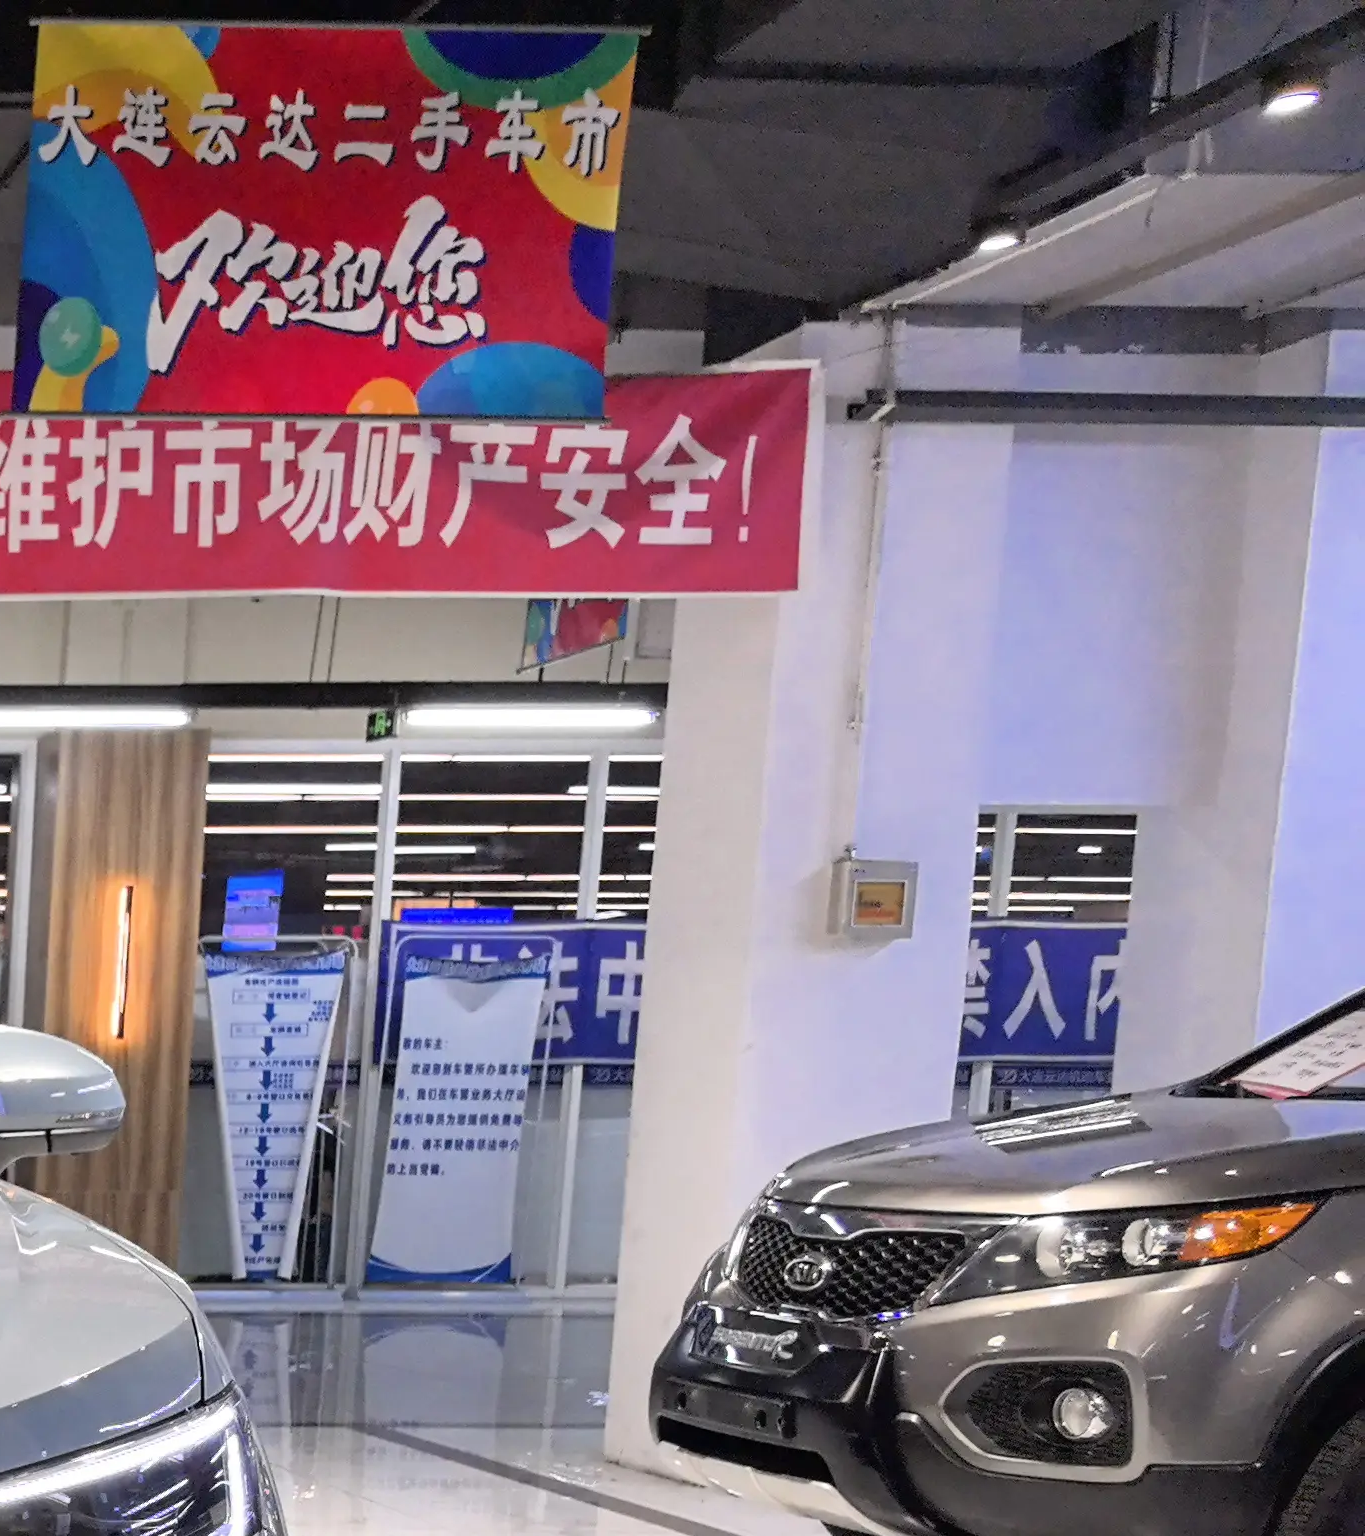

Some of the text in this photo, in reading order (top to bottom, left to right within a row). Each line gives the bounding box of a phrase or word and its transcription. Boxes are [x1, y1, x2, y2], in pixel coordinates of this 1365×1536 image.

[38, 84, 622, 178] 大连云达二手车市
[147, 194, 486, 375] 欢迎您
